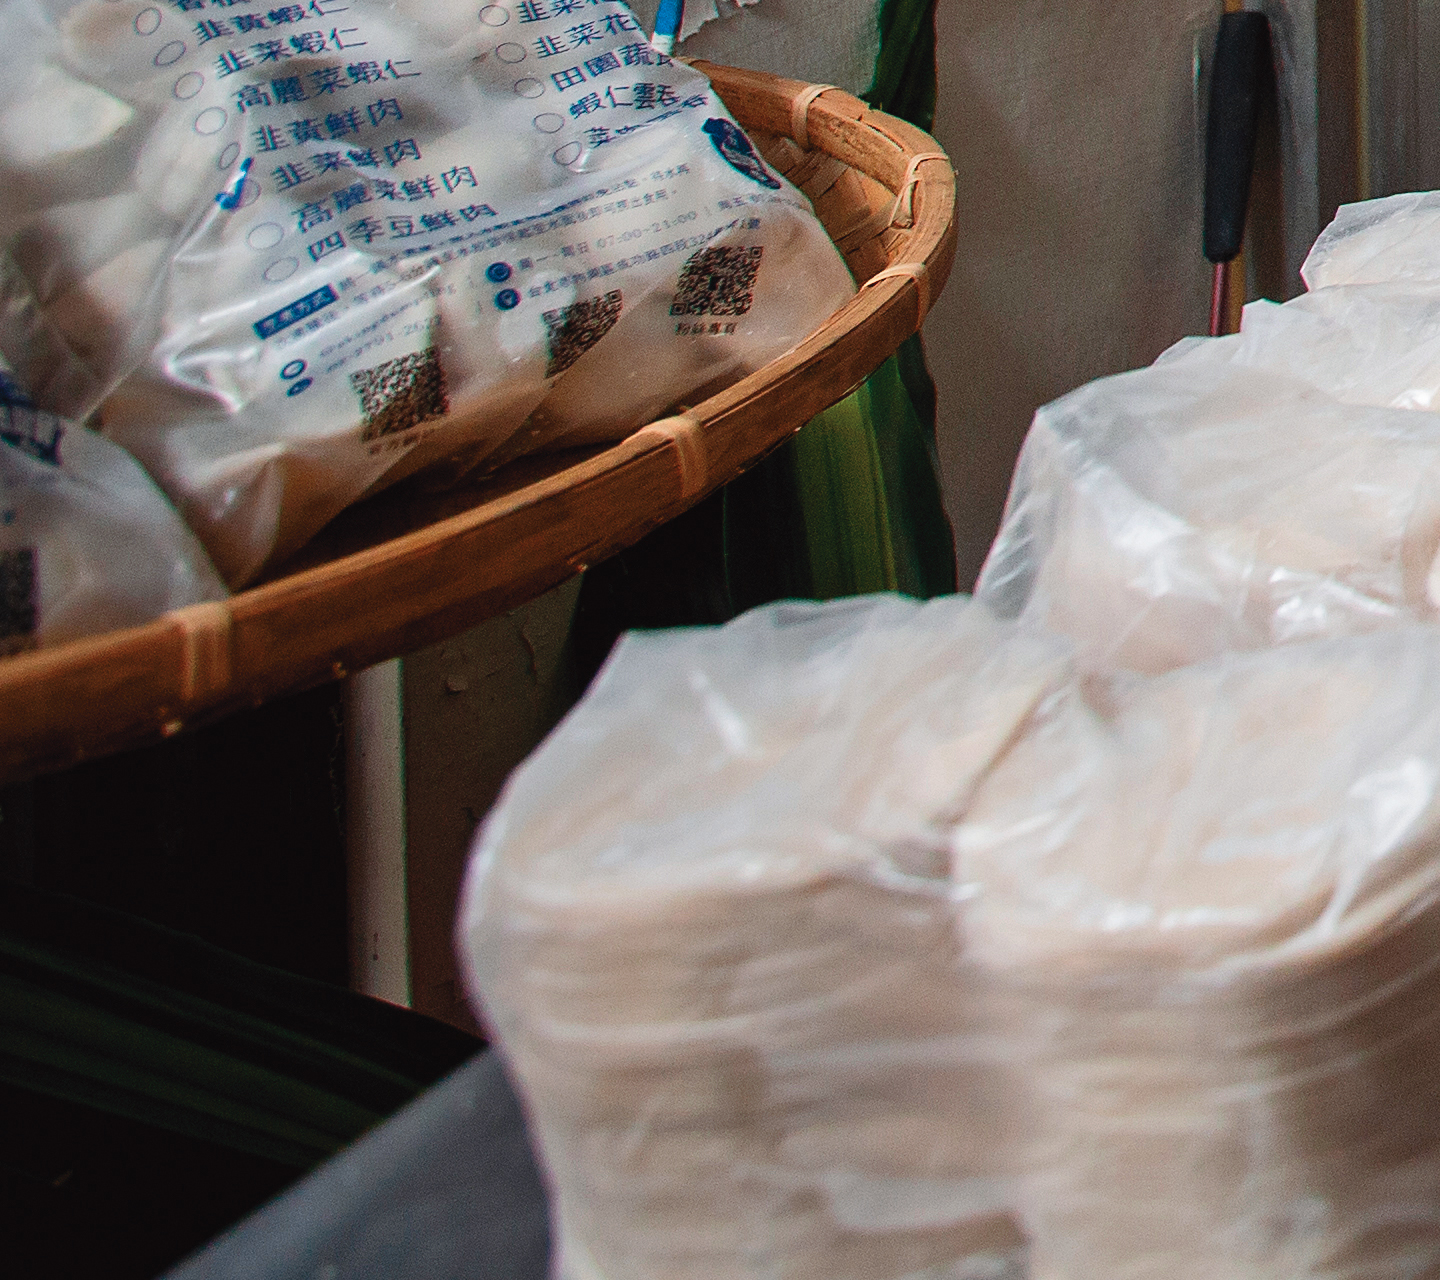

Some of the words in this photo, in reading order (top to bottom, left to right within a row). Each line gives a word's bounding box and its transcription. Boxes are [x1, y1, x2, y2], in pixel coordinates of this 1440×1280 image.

[231, 59, 422, 114] 高麗菜蝦仁
